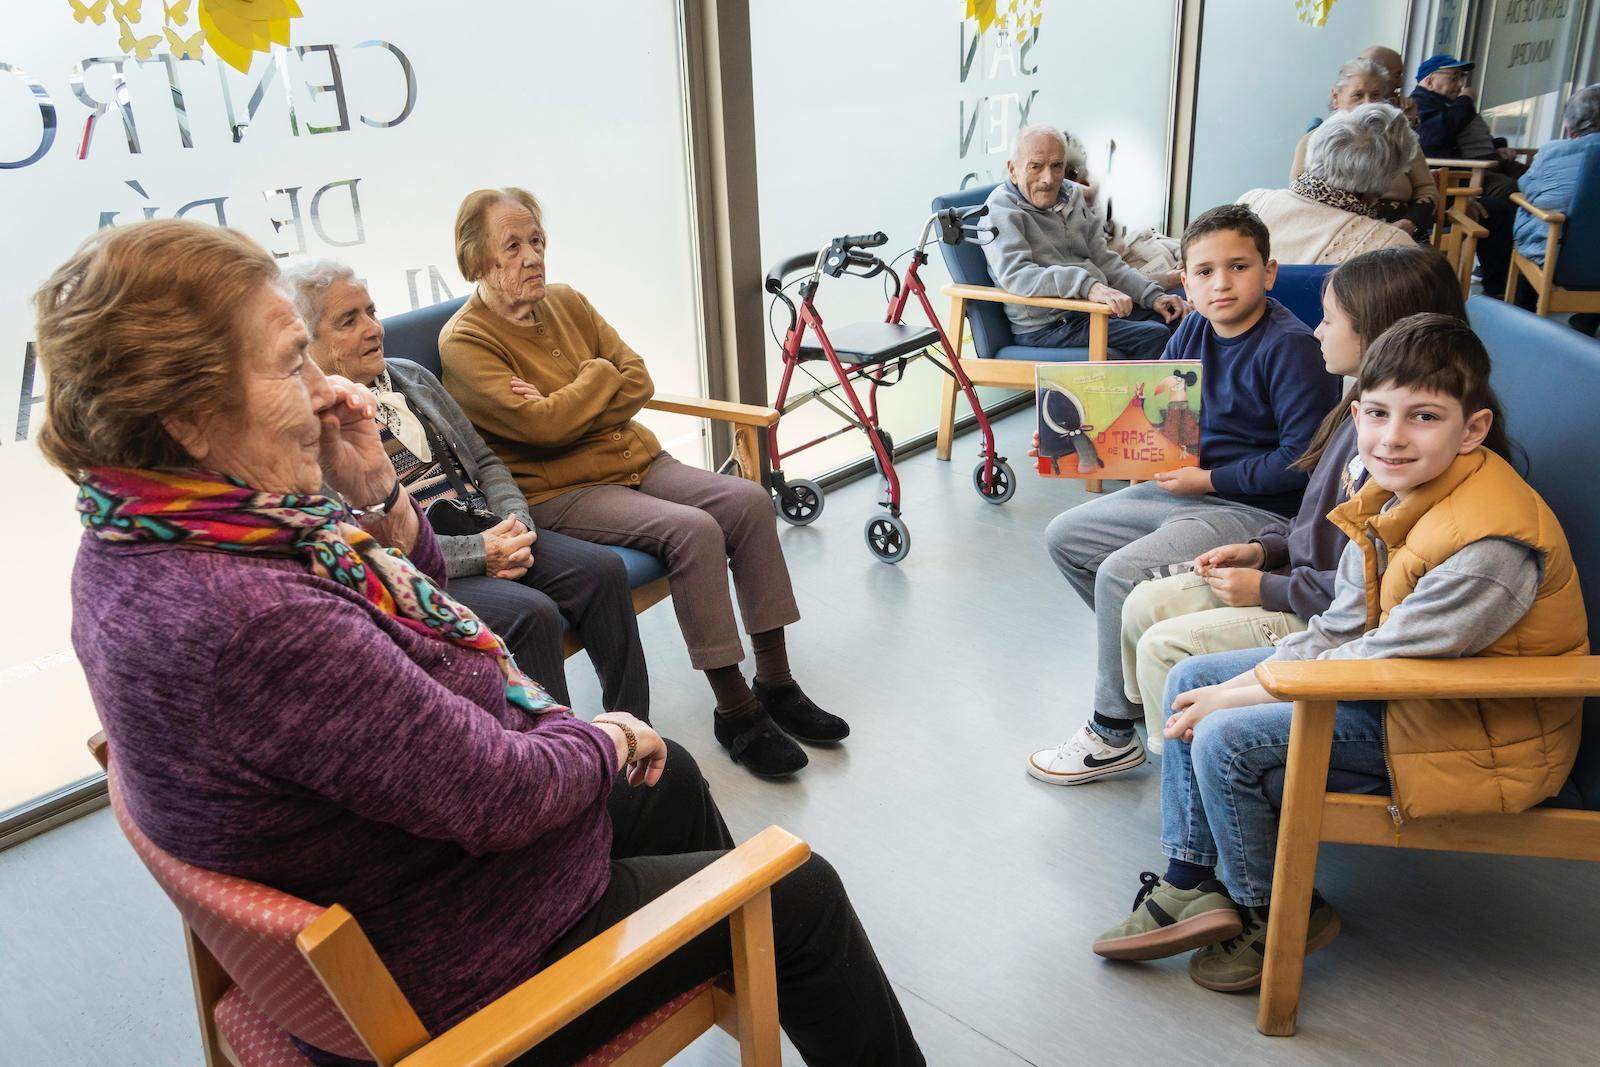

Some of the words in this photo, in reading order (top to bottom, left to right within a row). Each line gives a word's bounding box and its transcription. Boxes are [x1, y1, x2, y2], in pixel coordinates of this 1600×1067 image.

[1098, 432, 1106, 444] O
[1111, 430, 1155, 446] TRAXE
[1108, 446, 1119, 456] DE
[1123, 447, 1164, 462] LUCES
